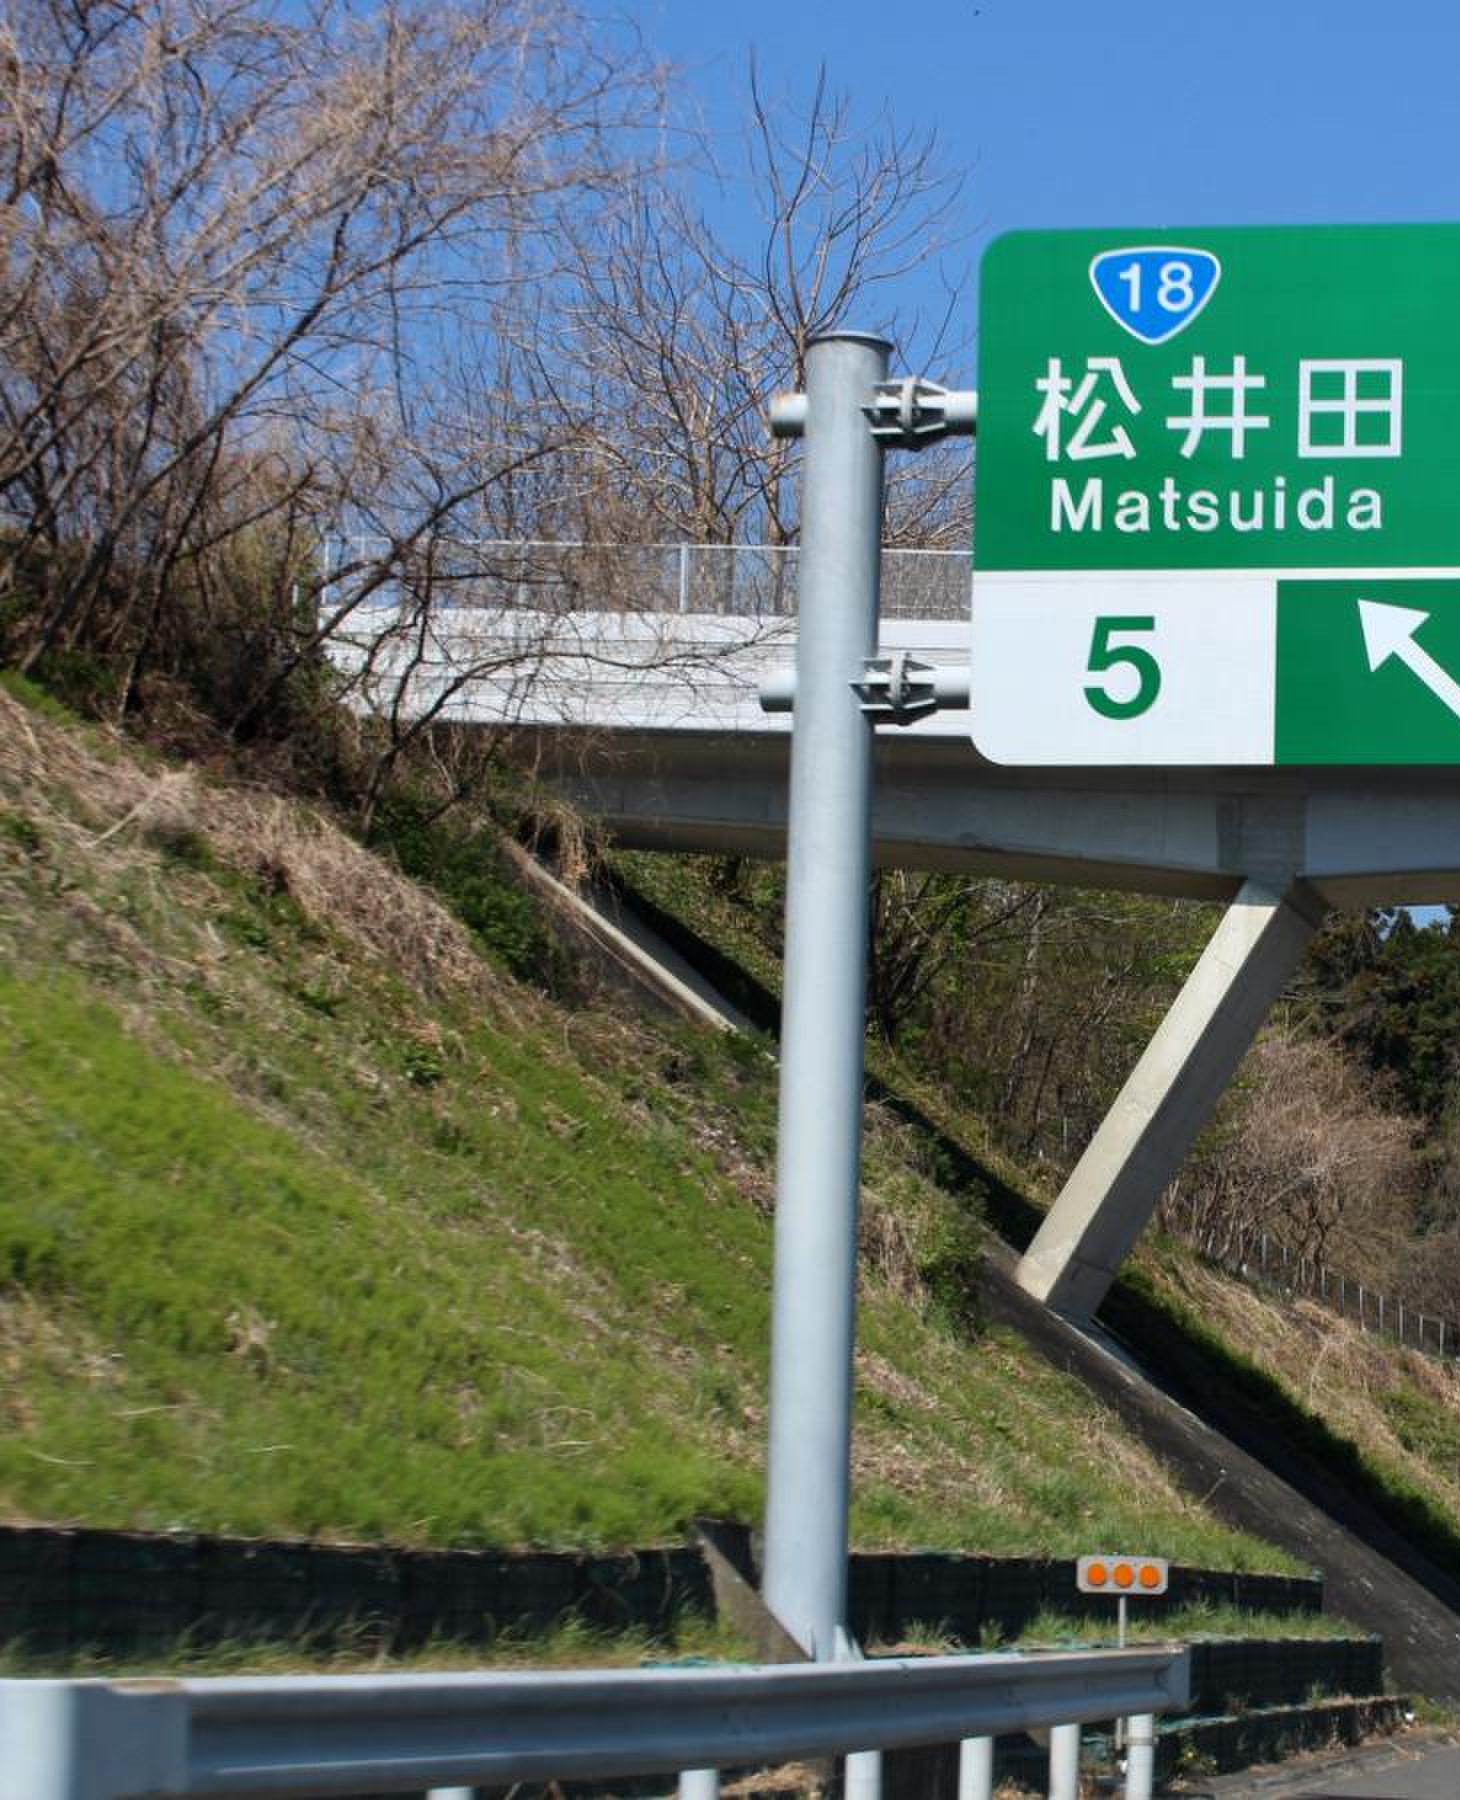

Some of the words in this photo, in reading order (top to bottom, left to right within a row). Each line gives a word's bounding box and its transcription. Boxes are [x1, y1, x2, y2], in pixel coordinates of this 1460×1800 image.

[1117, 261, 1195, 313] 18
[1033, 354, 1403, 461] 松井田
[1049, 475, 1383, 532] Matsuida
[1082, 615, 1162, 721] 5
